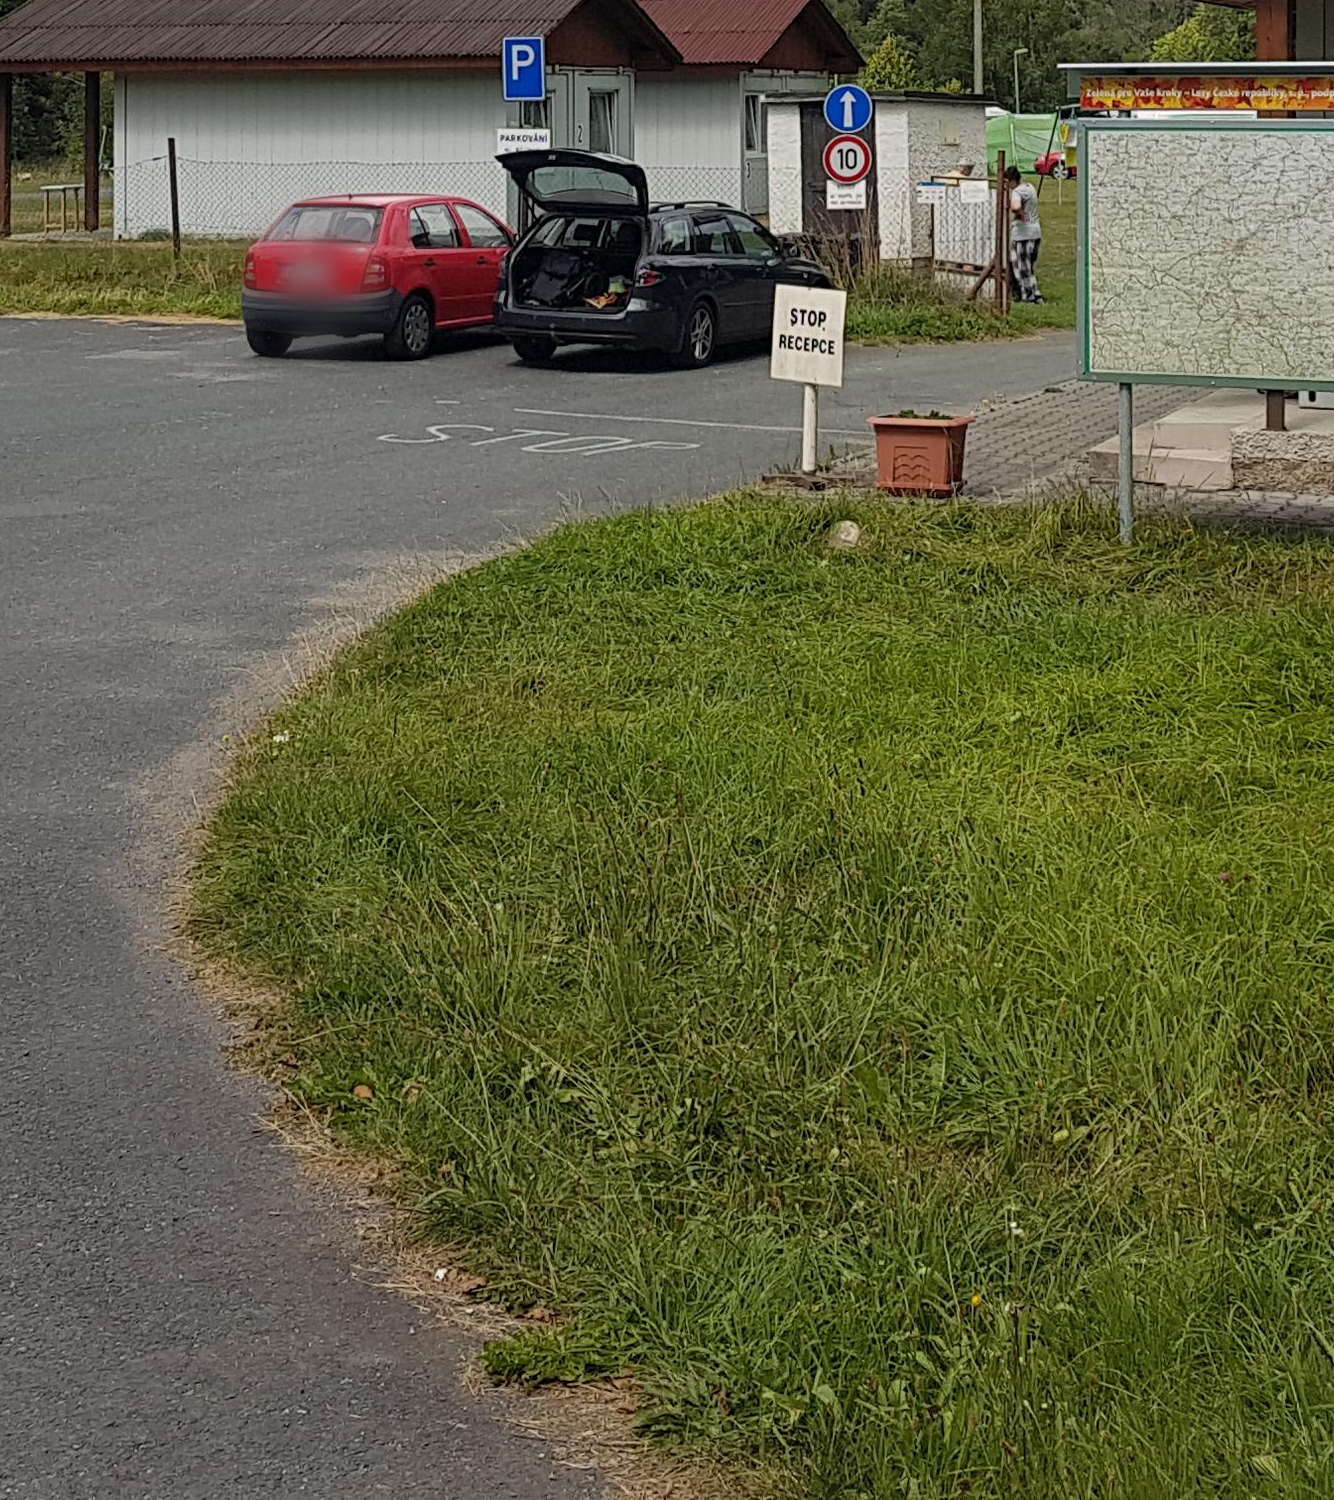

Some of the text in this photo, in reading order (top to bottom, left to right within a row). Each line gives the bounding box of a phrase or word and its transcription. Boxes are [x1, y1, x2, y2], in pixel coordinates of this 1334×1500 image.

[511, 44, 535, 81] P
[1086, 88, 1116, 98] Zelená
[1117, 89, 1132, 98] pro
[1134, 87, 1155, 97] Vaše
[1156, 88, 1183, 99] kroky
[1192, 88, 1211, 99] Lesy
[1213, 87, 1240, 98] České
[499, 132, 548, 143] PARKOVÁNÍ
[837, 148, 858, 170] 10
[790, 308, 827, 328] STOP
[779, 334, 835, 356] RECEPCE
[376, 424, 700, 456] STOP
